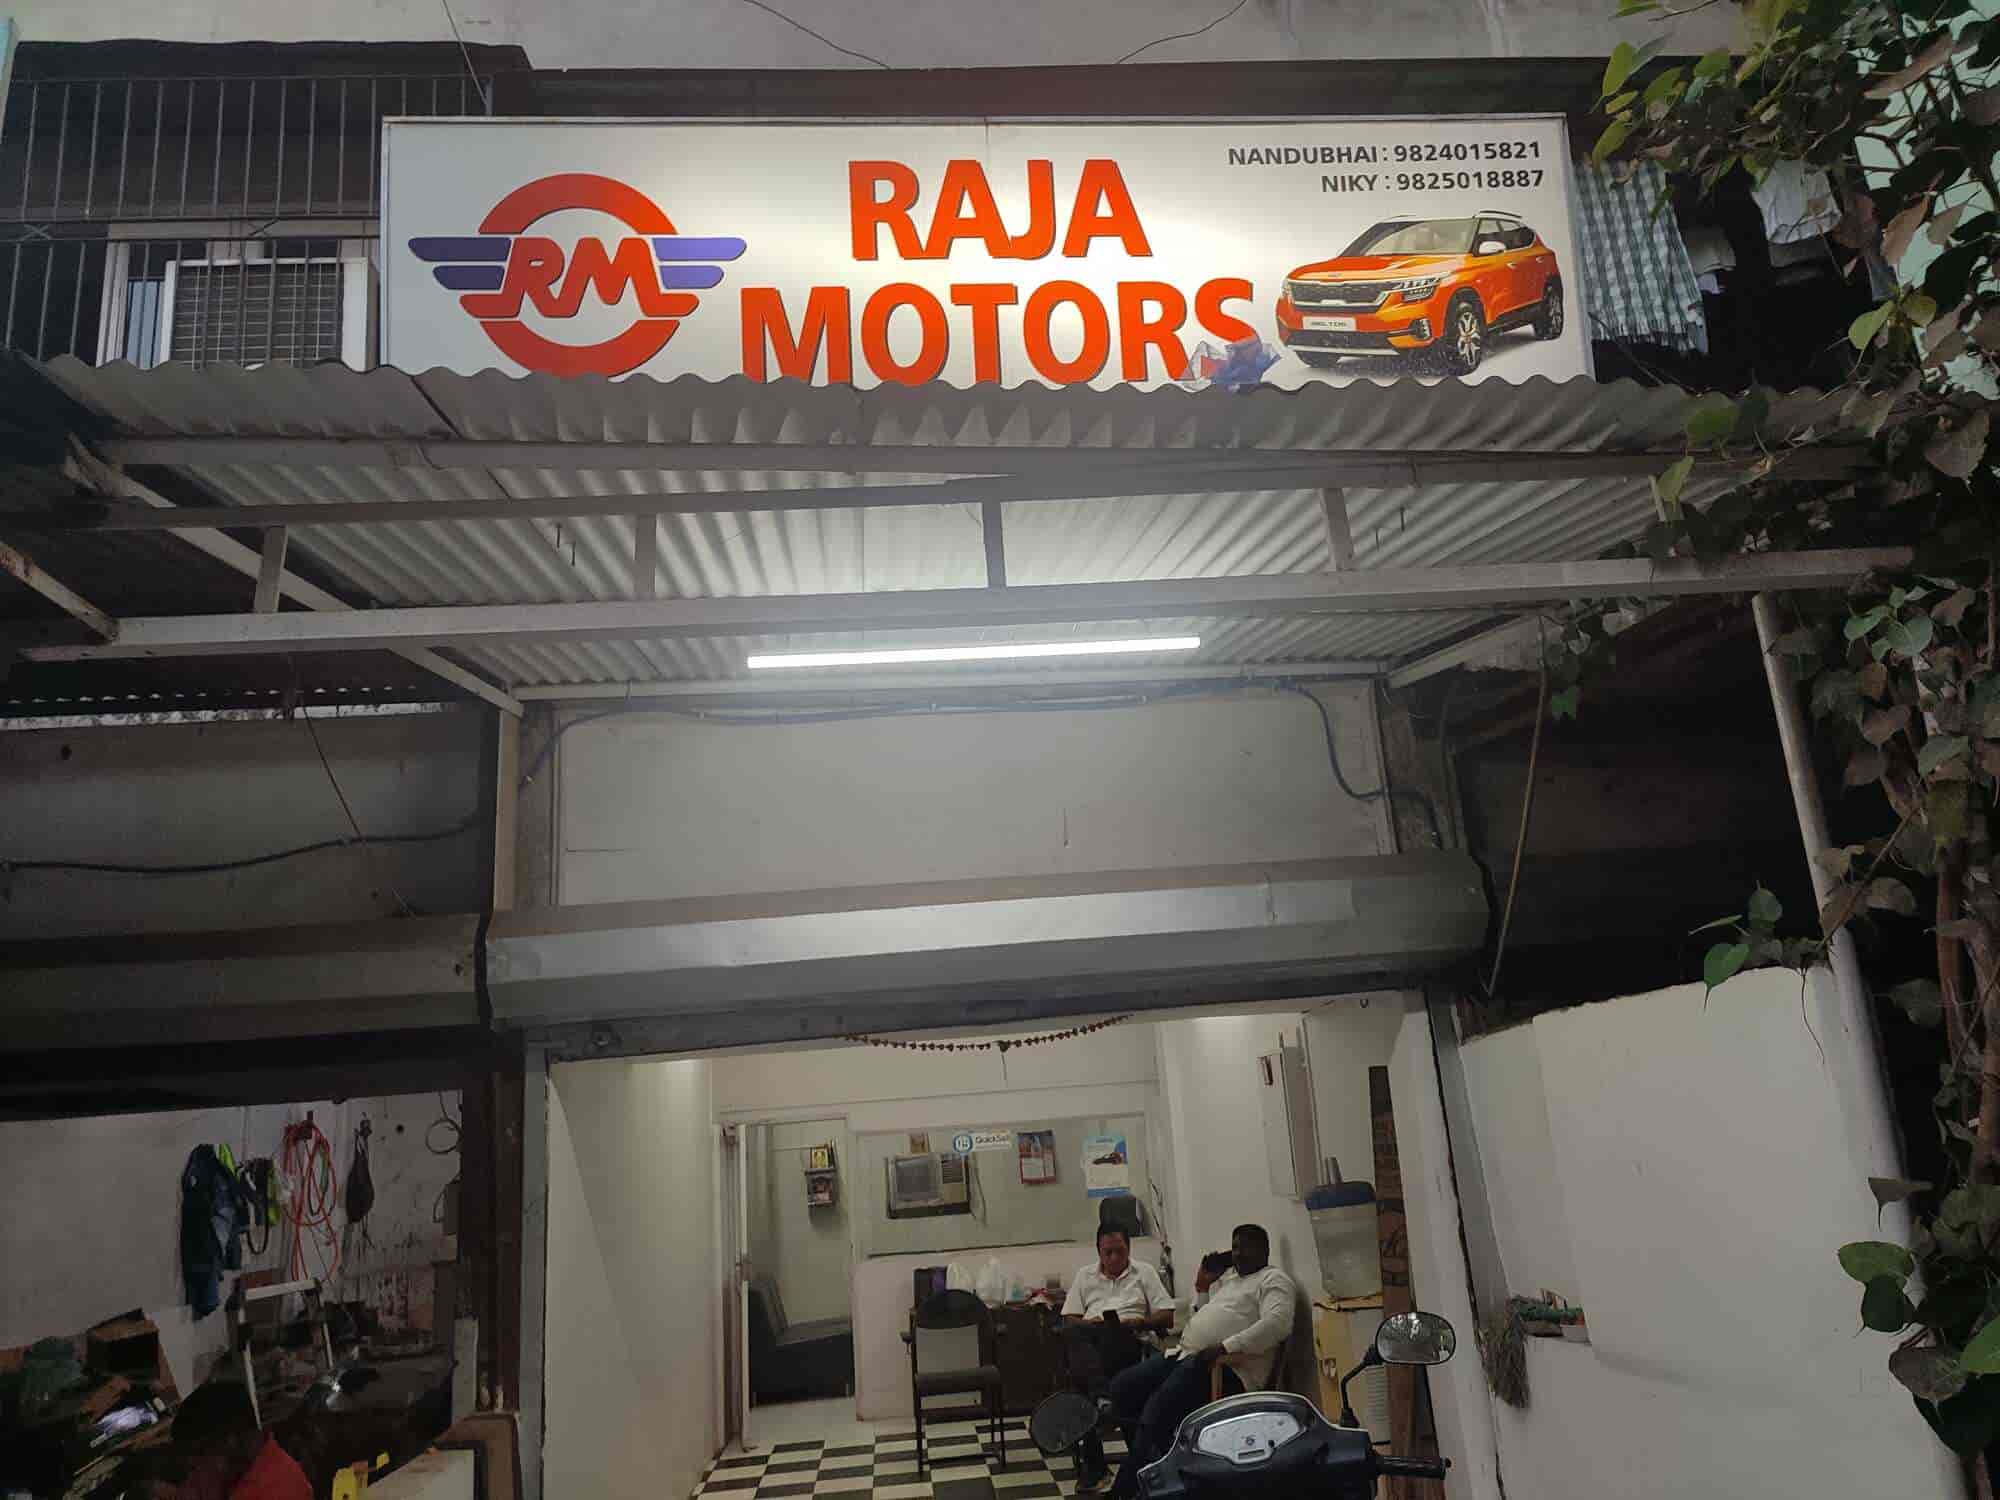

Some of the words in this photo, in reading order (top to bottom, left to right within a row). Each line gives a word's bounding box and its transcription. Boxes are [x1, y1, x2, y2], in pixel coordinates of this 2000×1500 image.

[1394, 141, 1540, 162] 9824015821
[1396, 170, 1544, 190] 9825018887
[849, 159, 1152, 261] RAJA
[458, 236, 699, 318] RM
[741, 278, 1262, 387] MOTORS
